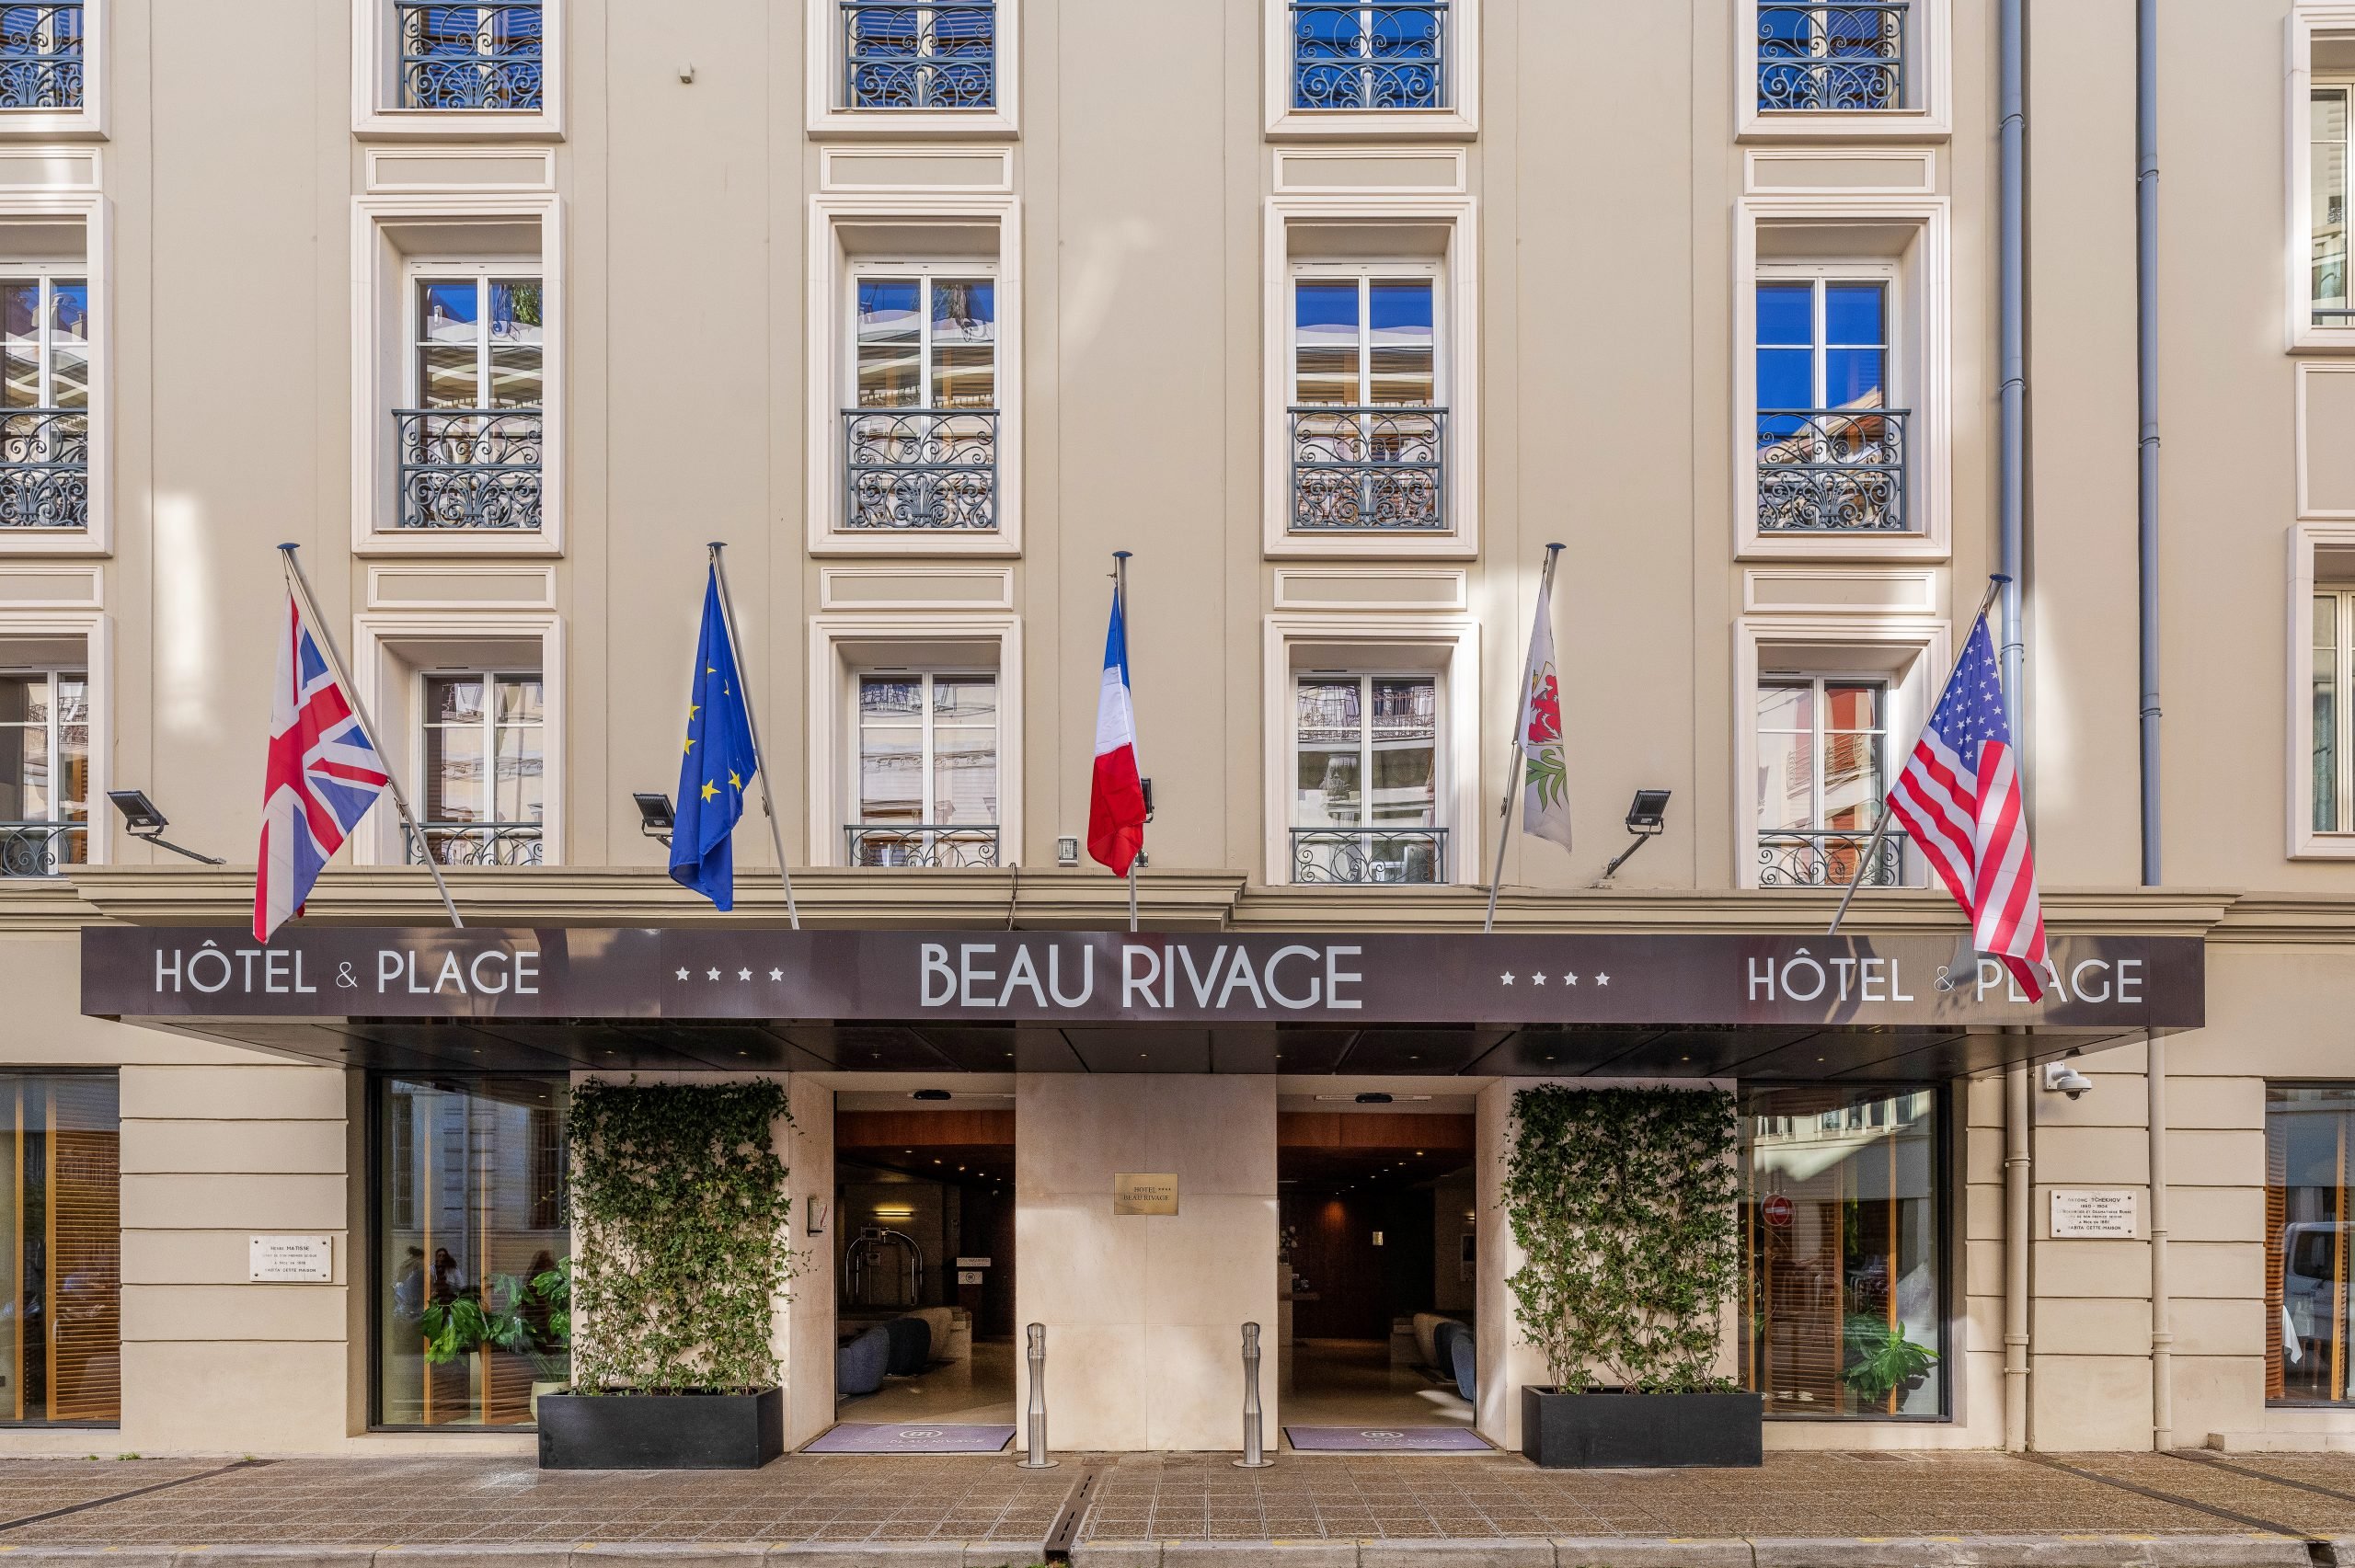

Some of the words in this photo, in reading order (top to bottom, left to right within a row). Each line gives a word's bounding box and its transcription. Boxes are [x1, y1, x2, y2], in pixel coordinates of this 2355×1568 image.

[155, 939, 317, 993] HÔTEL
[336, 961, 358, 989] &
[378, 950, 540, 994] PLAGE
[921, 943, 1094, 1008] BEAU
[1122, 944, 1362, 1010] RIVAGE
[1748, 947, 1914, 1002] HÔTEL
[1934, 966, 1956, 992] &
